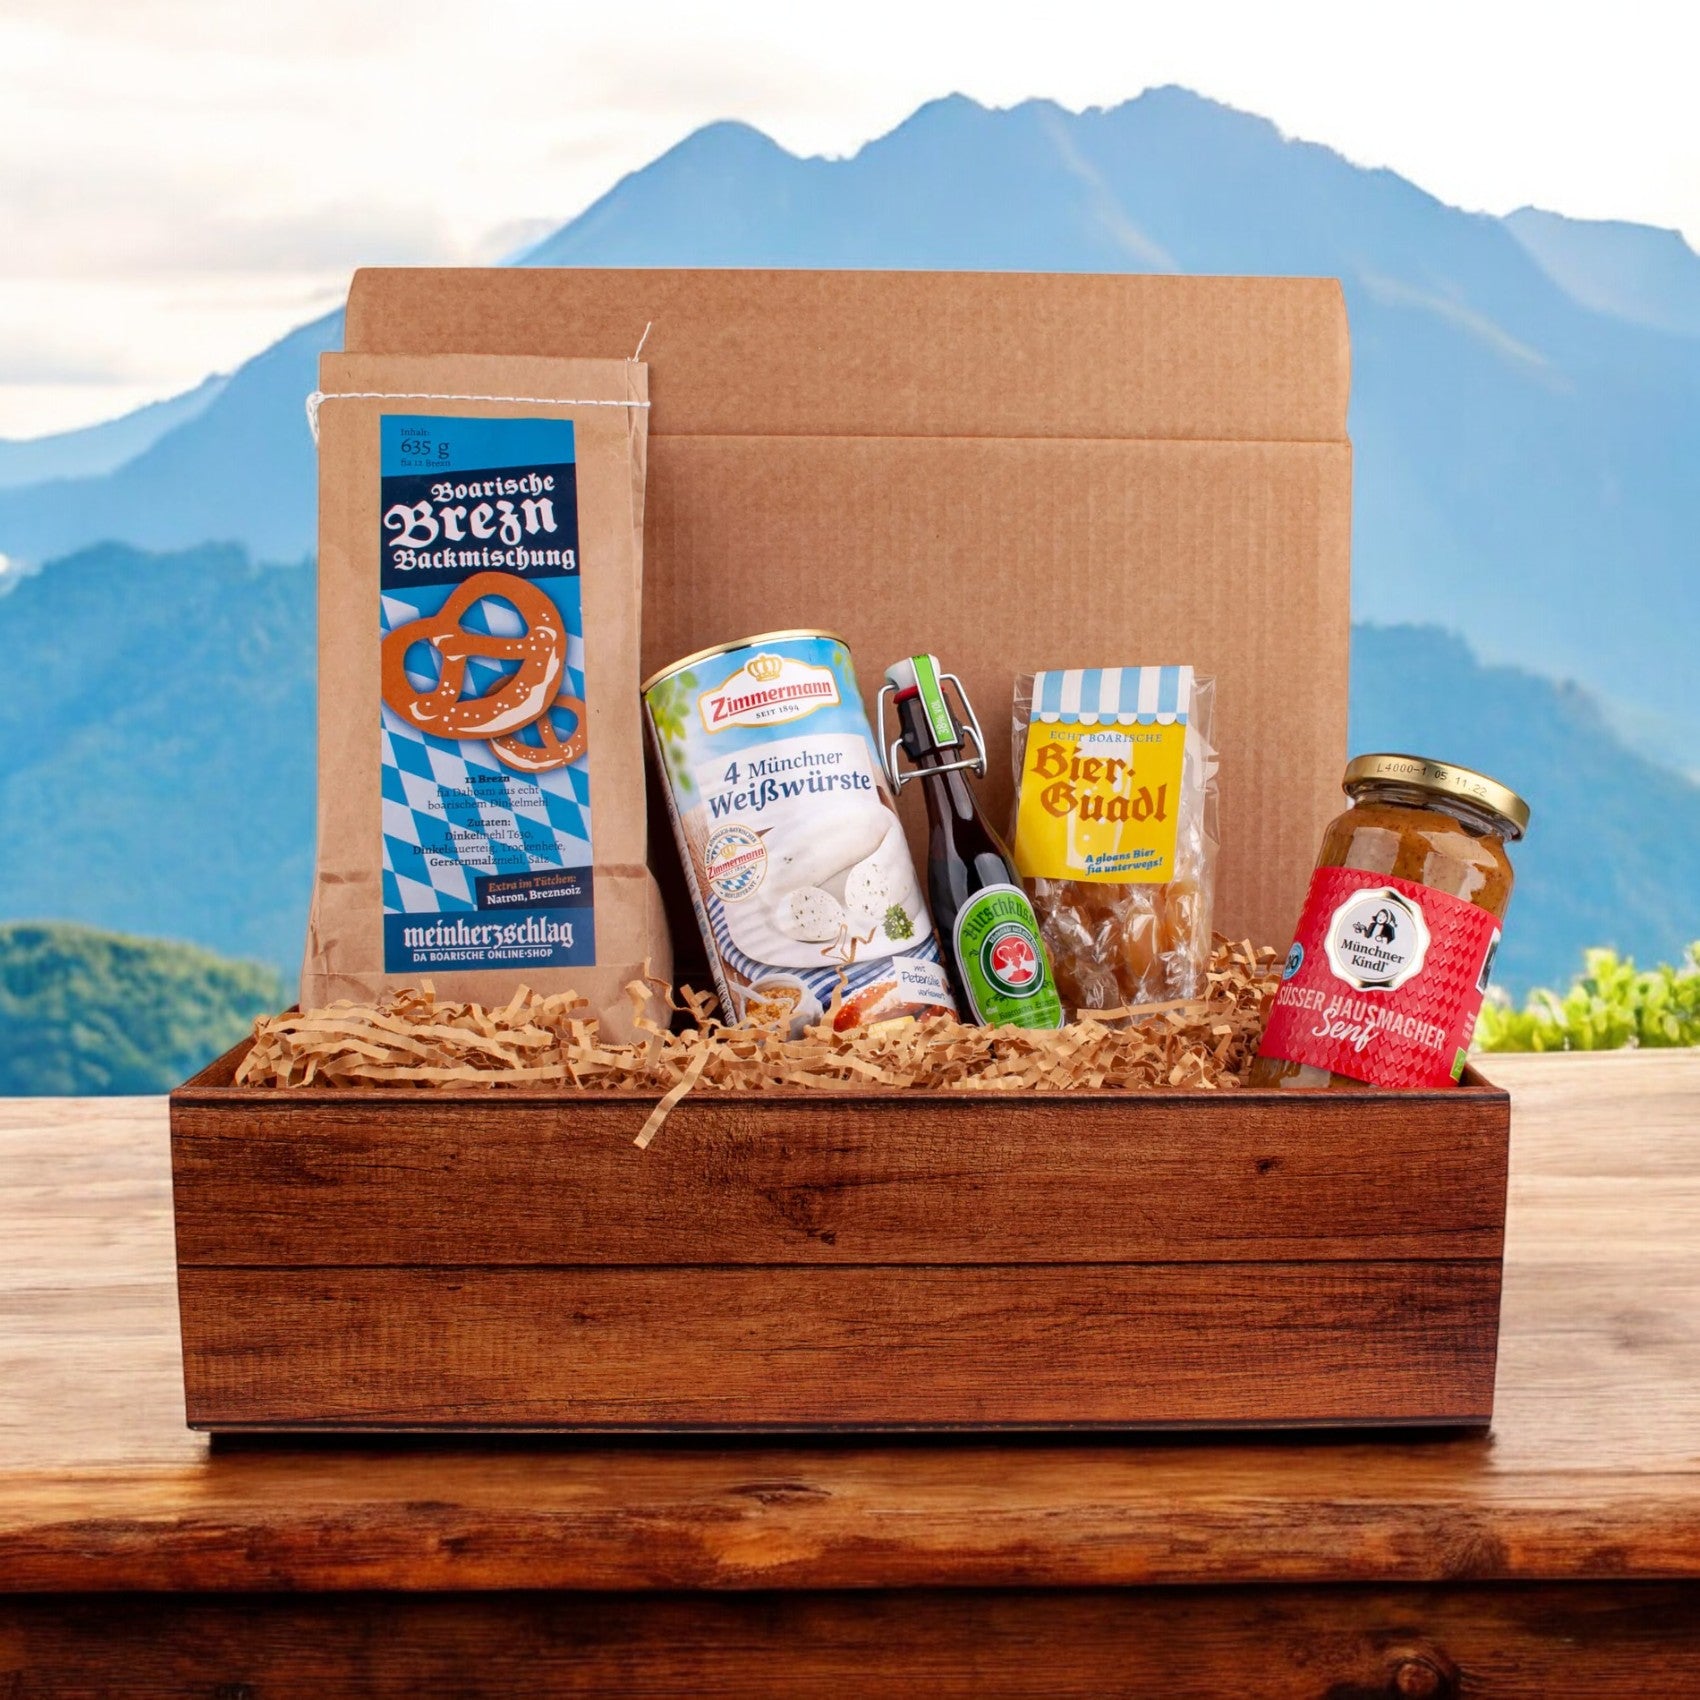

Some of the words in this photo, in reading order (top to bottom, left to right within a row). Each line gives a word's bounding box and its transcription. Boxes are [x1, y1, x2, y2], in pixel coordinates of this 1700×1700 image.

[400, 428, 430, 437] Inhalt:
[401, 438, 431, 455] 635
[437, 442, 449, 460] g
[425, 459, 451, 468] Brezn
[431, 473, 555, 502] Boarische
[383, 498, 558, 548] Brezn
[393, 546, 577, 571] Backmischung
[711, 682, 832, 722] Zimmermann
[756, 709, 776, 720] SEIT
[779, 704, 799, 714] 1894
[1050, 730, 1083, 742] ECHT
[1088, 731, 1163, 743] BOARISCHE
[724, 762, 741, 785] 4
[748, 751, 844, 779] Münchner
[478, 775, 510, 783] Brezn
[453, 787, 495, 797] Dahoam
[517, 787, 538, 796] echt
[708, 771, 871, 820] Weißwürste
[1040, 781, 1167, 823] Guadl
[428, 800, 487, 810] boarischem
[490, 797, 548, 808] Dinkelmehl
[467, 818, 511, 827] Zutaten:
[445, 830, 505, 841] Dinkelmehl
[412, 844, 496, 856] Dinkelsauerteig,
[501, 842, 565, 853] Trockenhefe,
[1084, 854, 1094, 863] A
[1095, 852, 1131, 865] gloans
[1133, 848, 1155, 858] Bier
[430, 857, 525, 868] Gerstenmalzmehl,
[707, 848, 764, 880] Zimmermann
[1085, 864, 1102, 876] fia
[1104, 857, 1164, 874] unterwegs!
[488, 881, 517, 894] Extra
[518, 879, 531, 889] im
[534, 874, 577, 888] Tütchen:
[486, 891, 527, 905] Natron,
[528, 885, 581, 901] Breznsoiz
[403, 916, 574, 951] meinherzschlag
[413, 951, 427, 962] DA
[430, 949, 485, 961] BOARISCHE
[1340, 939, 1404, 965] Münchner
[1351, 954, 1385, 974] Kindl
[1277, 983, 1325, 1012] SÜSSER
[1312, 1006, 1380, 1053] Senf
[1328, 994, 1446, 1051] HAUSMACHER
